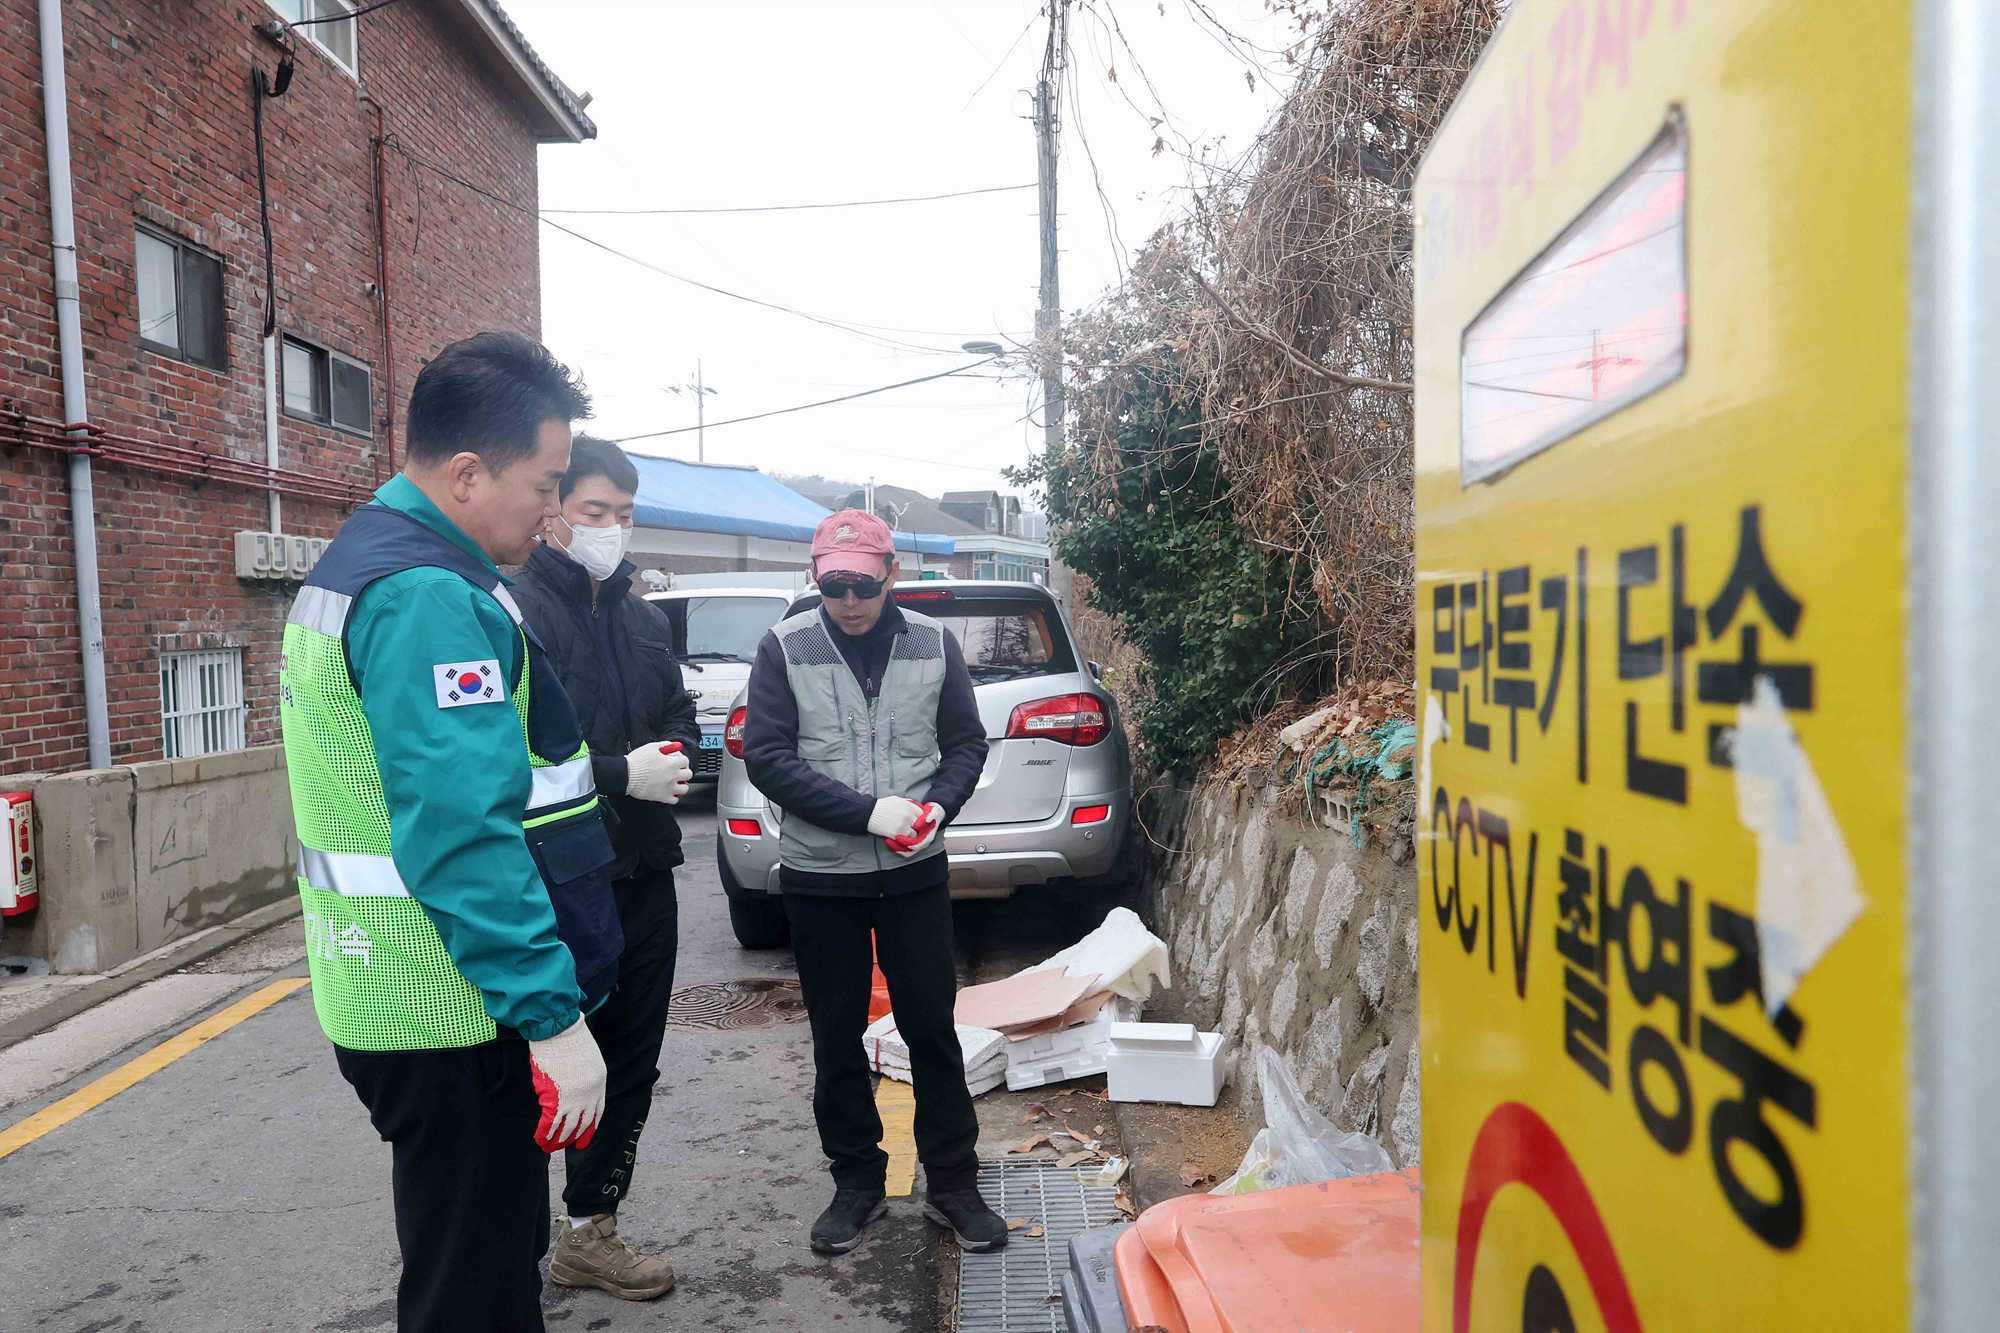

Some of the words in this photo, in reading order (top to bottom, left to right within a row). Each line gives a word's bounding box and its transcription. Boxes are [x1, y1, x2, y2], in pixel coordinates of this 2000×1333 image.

[1430, 545, 1588, 784] 무단투기
[1617, 504, 1816, 812] 단속
[1431, 786, 1538, 1000] CCTV
[1556, 828, 1819, 1253] 촬영중
